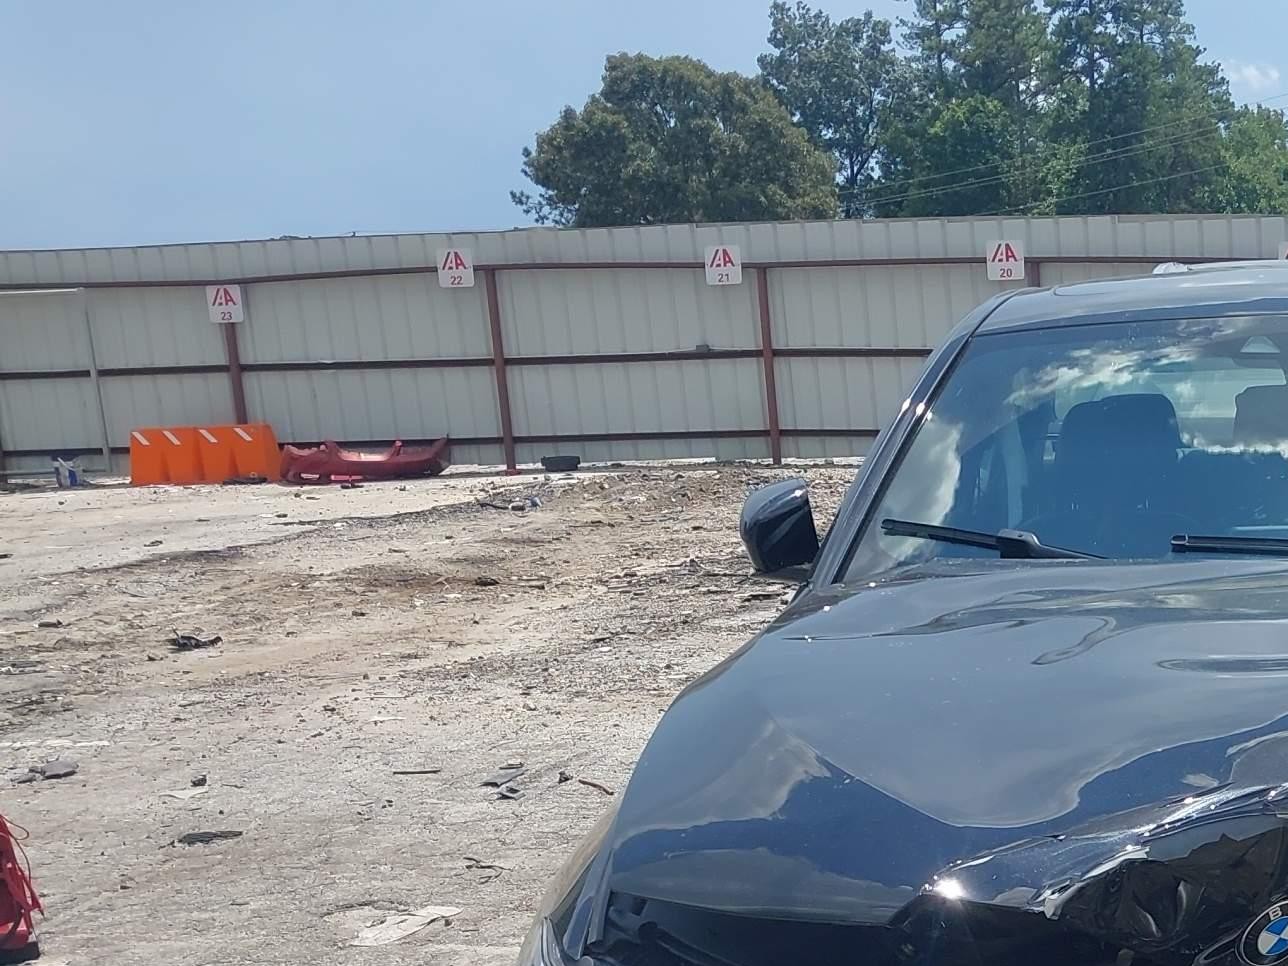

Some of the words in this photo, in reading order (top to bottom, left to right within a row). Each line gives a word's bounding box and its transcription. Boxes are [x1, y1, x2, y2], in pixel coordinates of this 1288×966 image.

[1000, 268, 1012, 277] 20
[451, 276, 463, 285] 22
[718, 274, 729, 282] 21
[221, 312, 232, 320] 23
